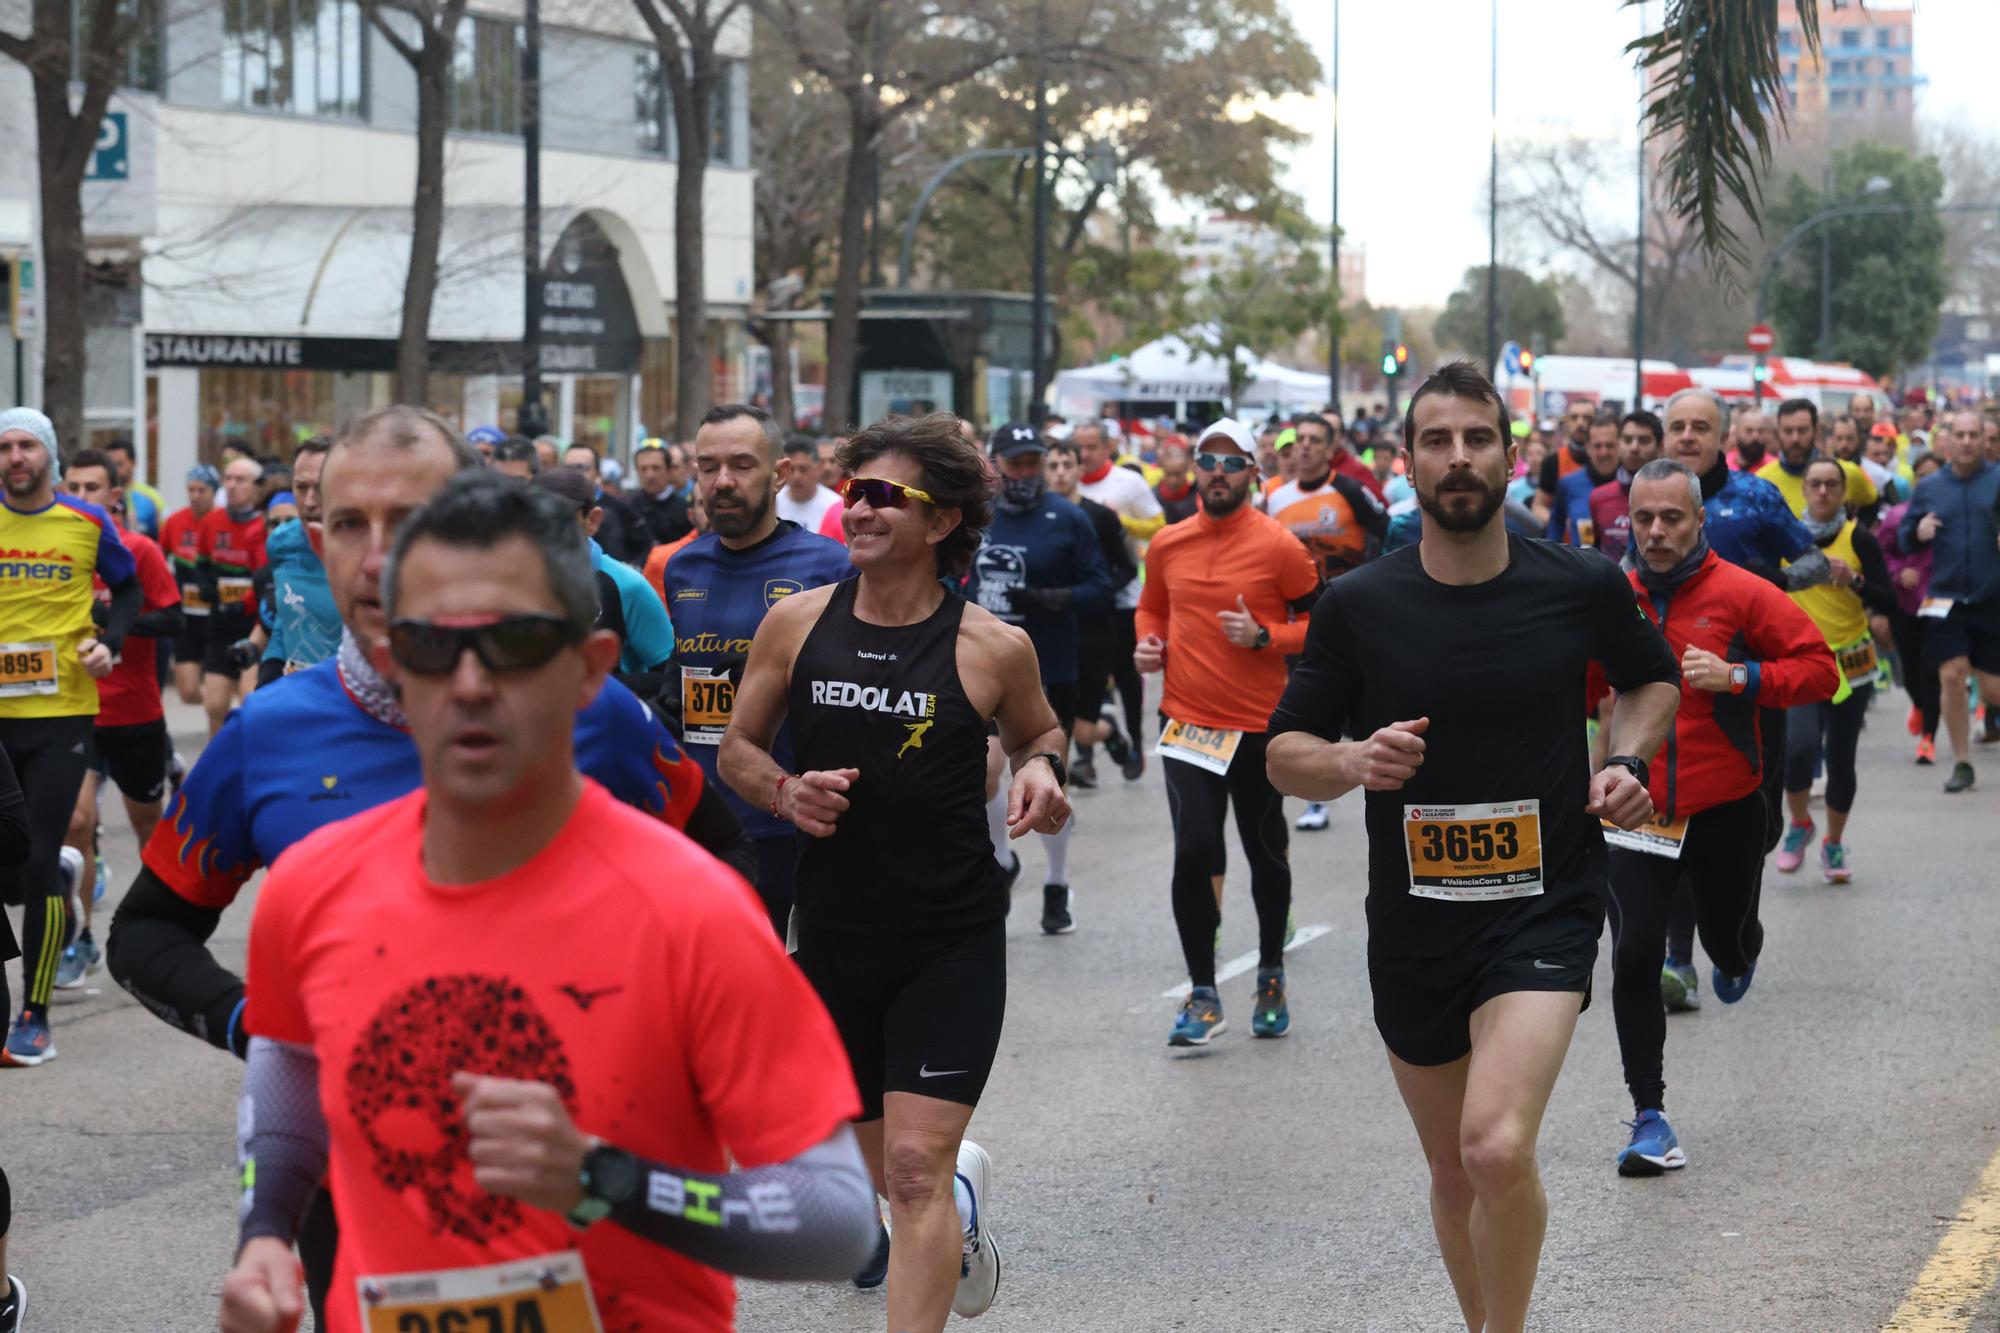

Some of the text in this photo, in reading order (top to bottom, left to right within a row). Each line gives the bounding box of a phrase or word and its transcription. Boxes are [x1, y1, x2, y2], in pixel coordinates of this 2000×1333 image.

[0, 652, 43, 676] 895
[858, 650, 887, 660] luanvi
[811, 680, 929, 718] REDOLAT
[926, 693, 937, 718] TEAM
[1421, 821, 1519, 862] 3653
[1441, 877, 1502, 886] #ValènciaCorre
